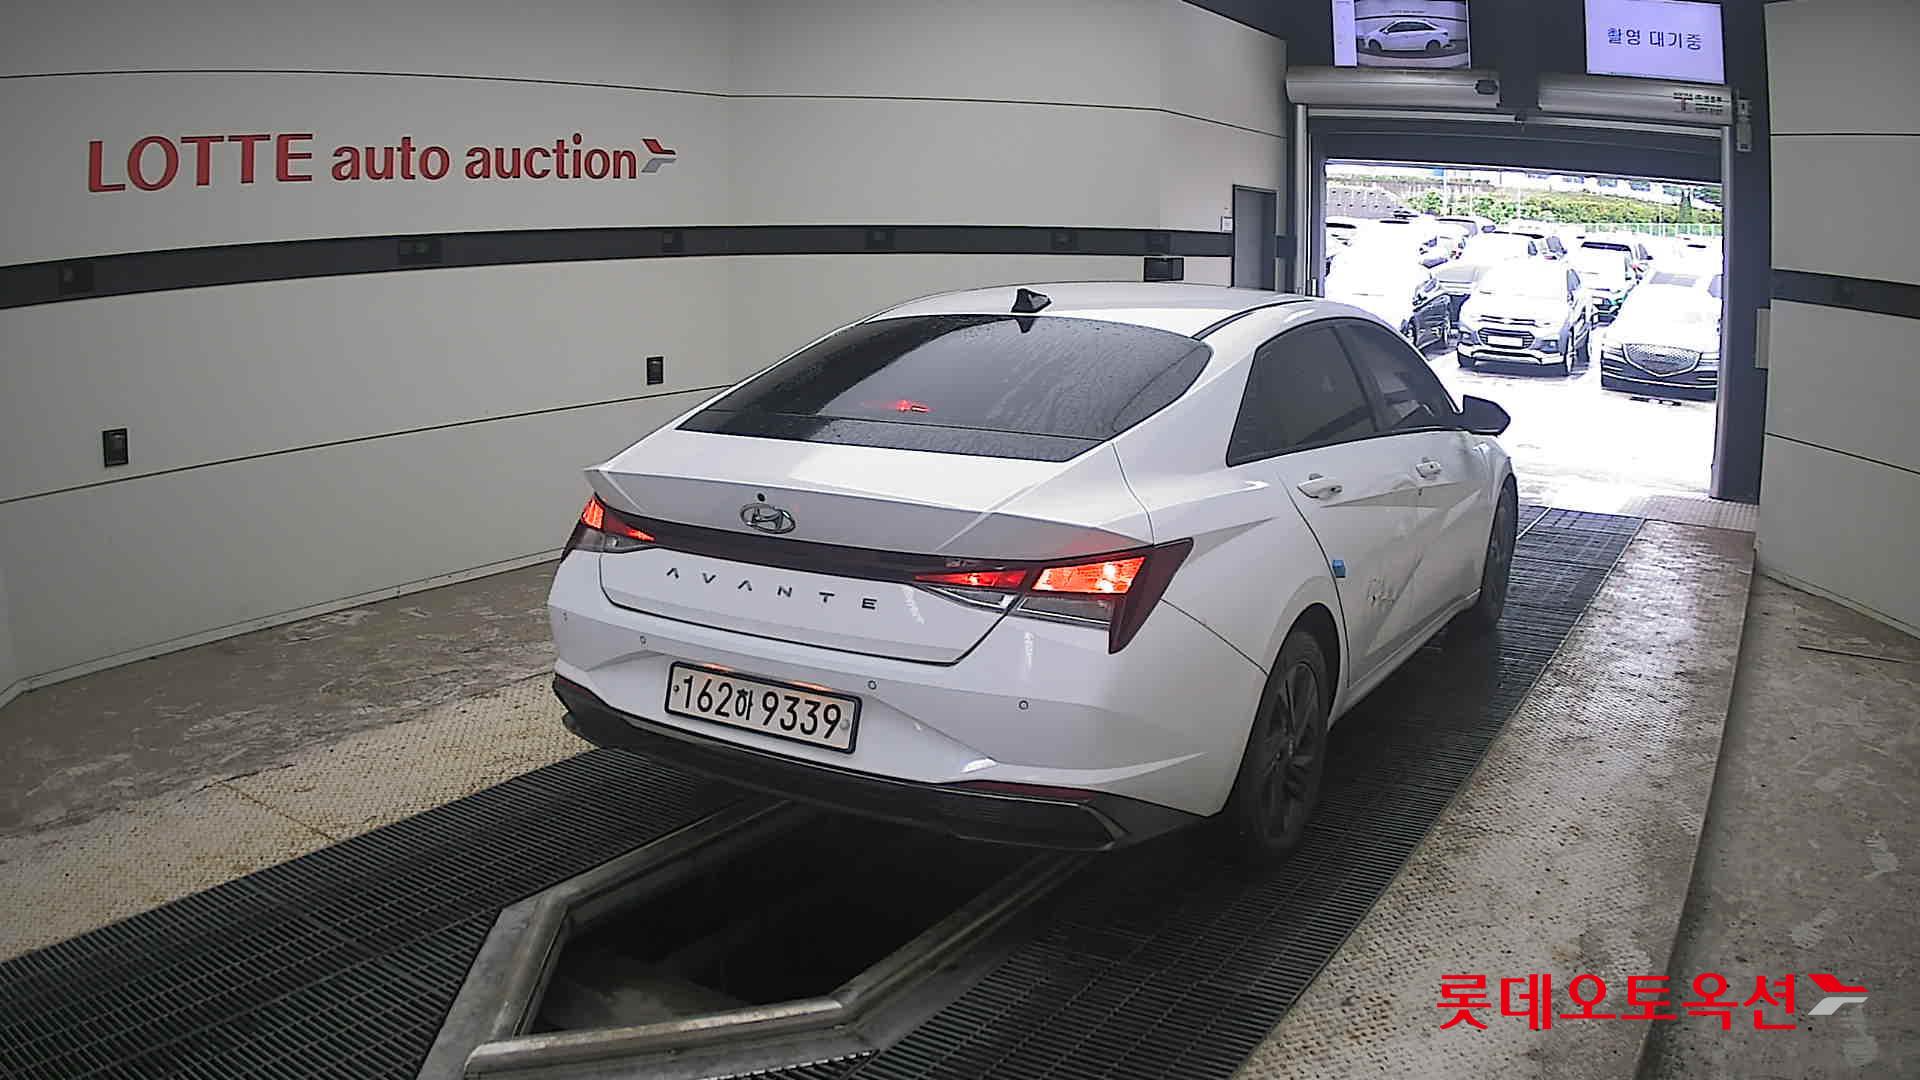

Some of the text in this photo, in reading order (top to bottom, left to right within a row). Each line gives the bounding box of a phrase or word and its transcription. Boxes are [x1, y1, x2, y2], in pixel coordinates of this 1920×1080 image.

[1648, 31, 1702, 51] 대기중
[88, 133, 638, 192] LOTTE auto auction
[666, 567, 878, 611] AVANTE
